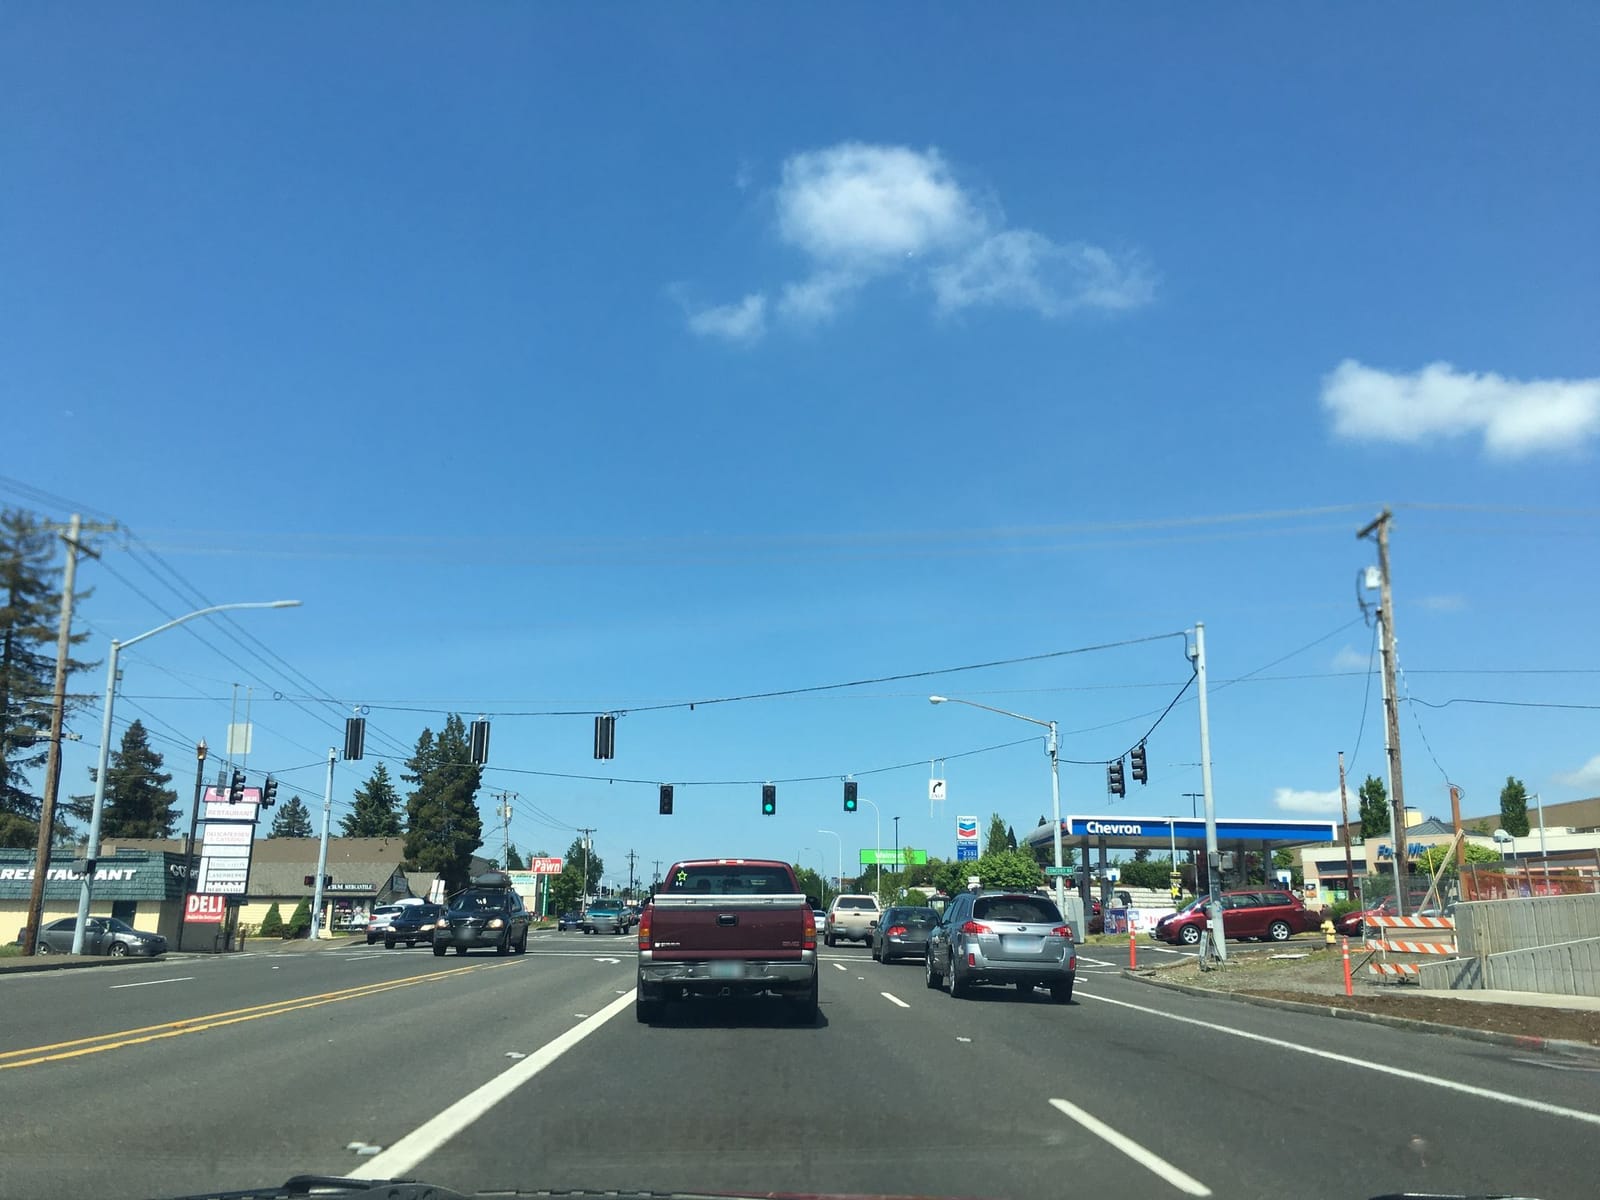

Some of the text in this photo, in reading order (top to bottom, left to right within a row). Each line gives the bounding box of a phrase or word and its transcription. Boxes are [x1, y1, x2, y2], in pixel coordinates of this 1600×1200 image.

[1086, 821, 1142, 834] Chevron
[1408, 842, 1436, 854] Ma
[534, 859, 560, 872] Pawn
[0, 869, 136, 880] RETAUANT
[188, 894, 223, 913] DELI
